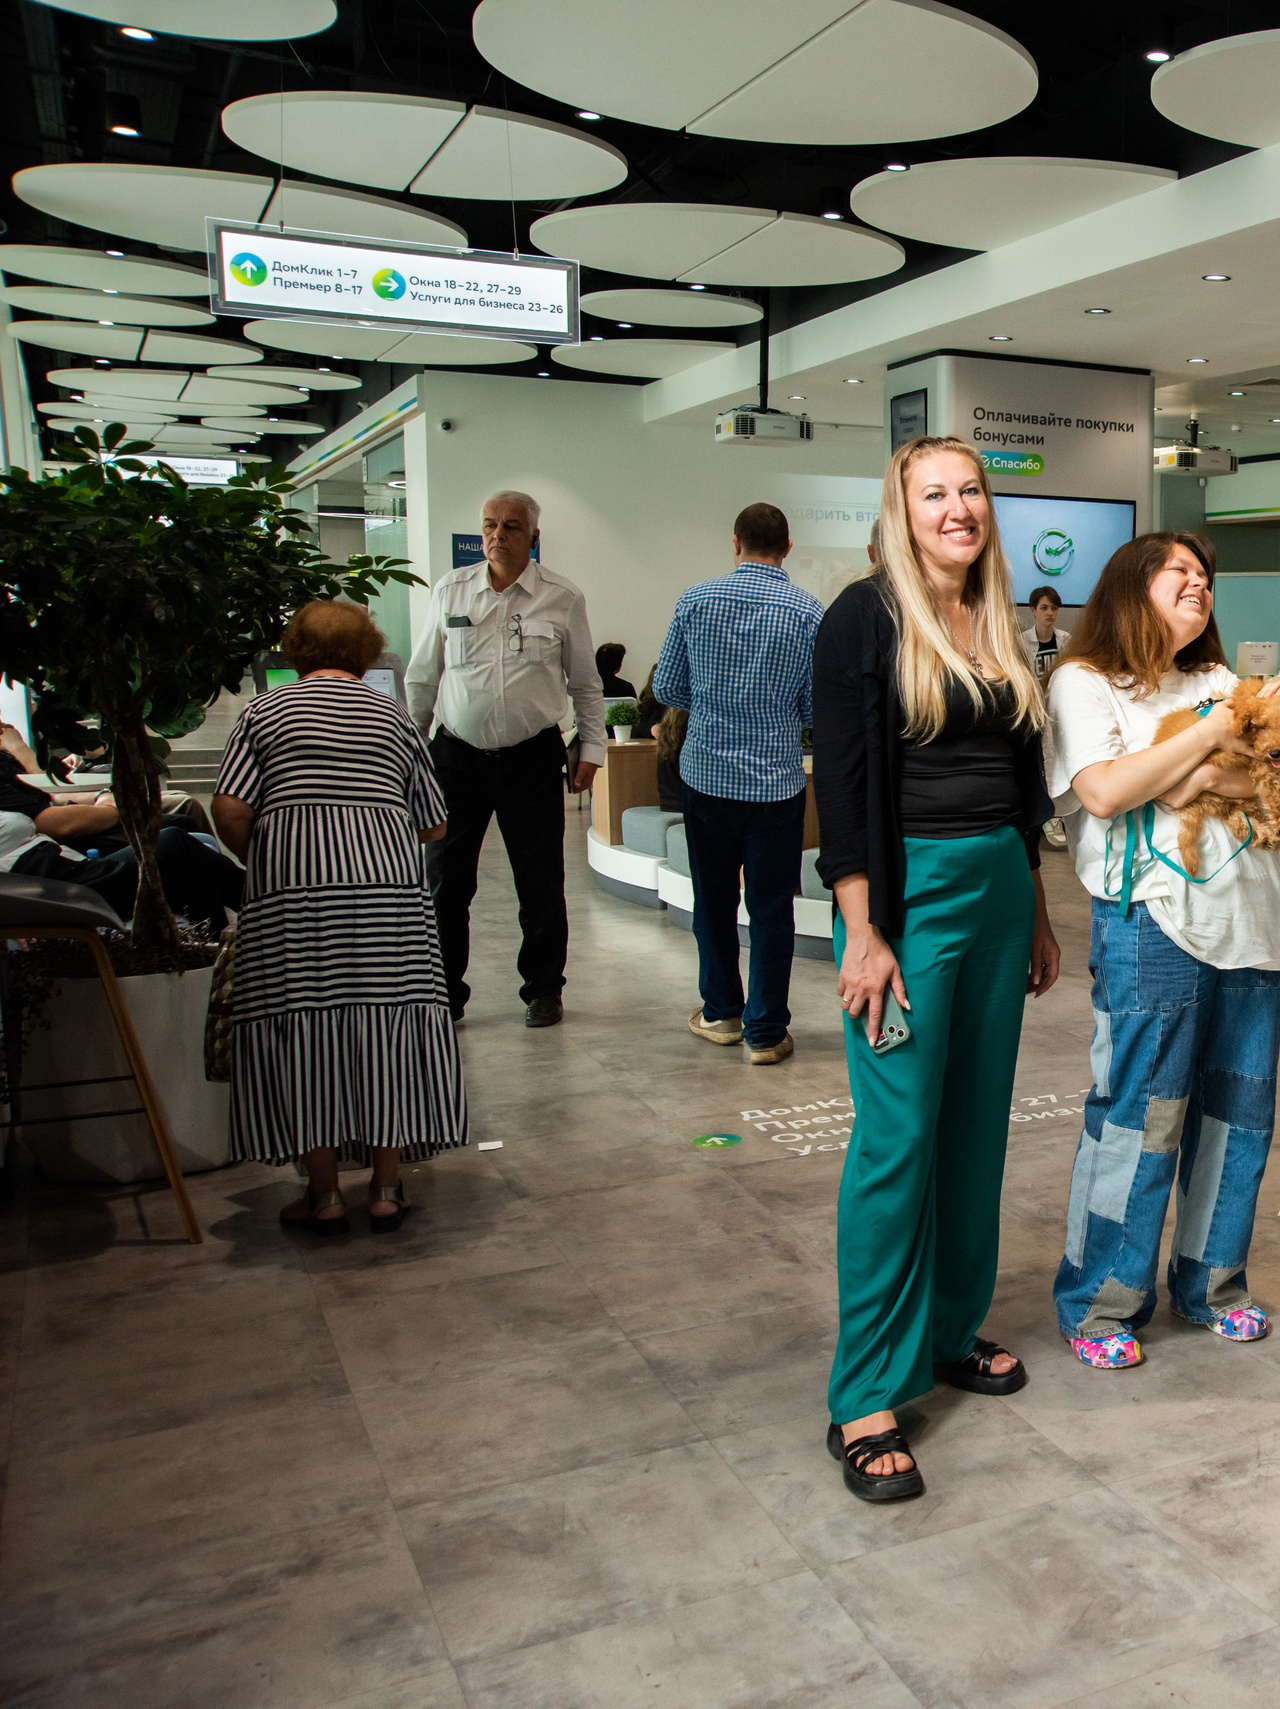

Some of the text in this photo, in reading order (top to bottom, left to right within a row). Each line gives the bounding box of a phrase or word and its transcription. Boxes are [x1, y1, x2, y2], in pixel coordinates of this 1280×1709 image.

[272, 261, 334, 277] ДомКлик
[273, 277, 332, 293] Премьер
[409, 276, 441, 288] Окна
[410, 291, 451, 304] Услуги
[454, 297, 475, 307] для
[479, 297, 525, 311] бизнеса
[973, 407, 1134, 433] Оплачивайте покупки
[973, 427, 1045, 446] бонусами
[992, 457, 1040, 470] Спасибо
[786, 508, 851, 523] одарить
[740, 1098, 854, 1122] ДомК
[1009, 1105, 1085, 1122] бизн
[753, 1111, 857, 1132] Прем
[771, 1126, 853, 1143] Окн
